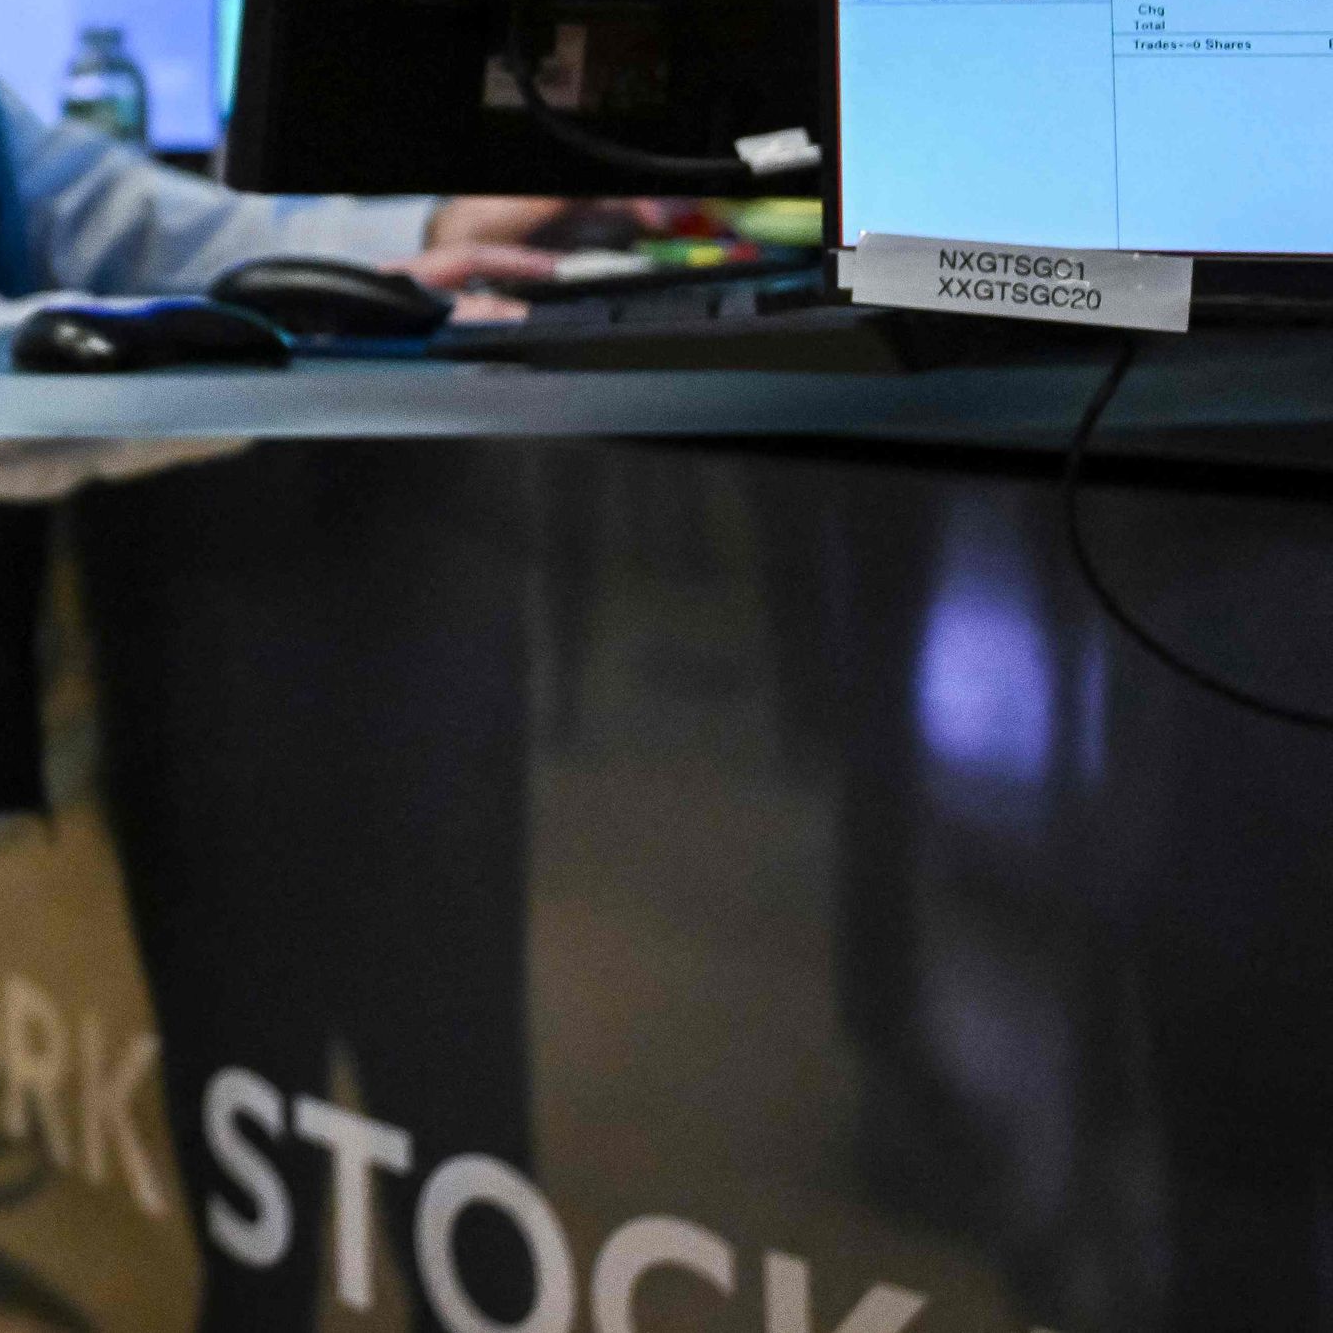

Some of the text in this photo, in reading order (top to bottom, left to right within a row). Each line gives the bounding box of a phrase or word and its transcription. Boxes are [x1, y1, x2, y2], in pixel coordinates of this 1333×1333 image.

[1138, 4, 1166, 18] Chg
[1134, 21, 1166, 32] Total
[1205, 37, 1252, 51] Shares
[939, 248, 1085, 281] NXGTSGC1
[938, 276, 1102, 311] XXGTSGC20
